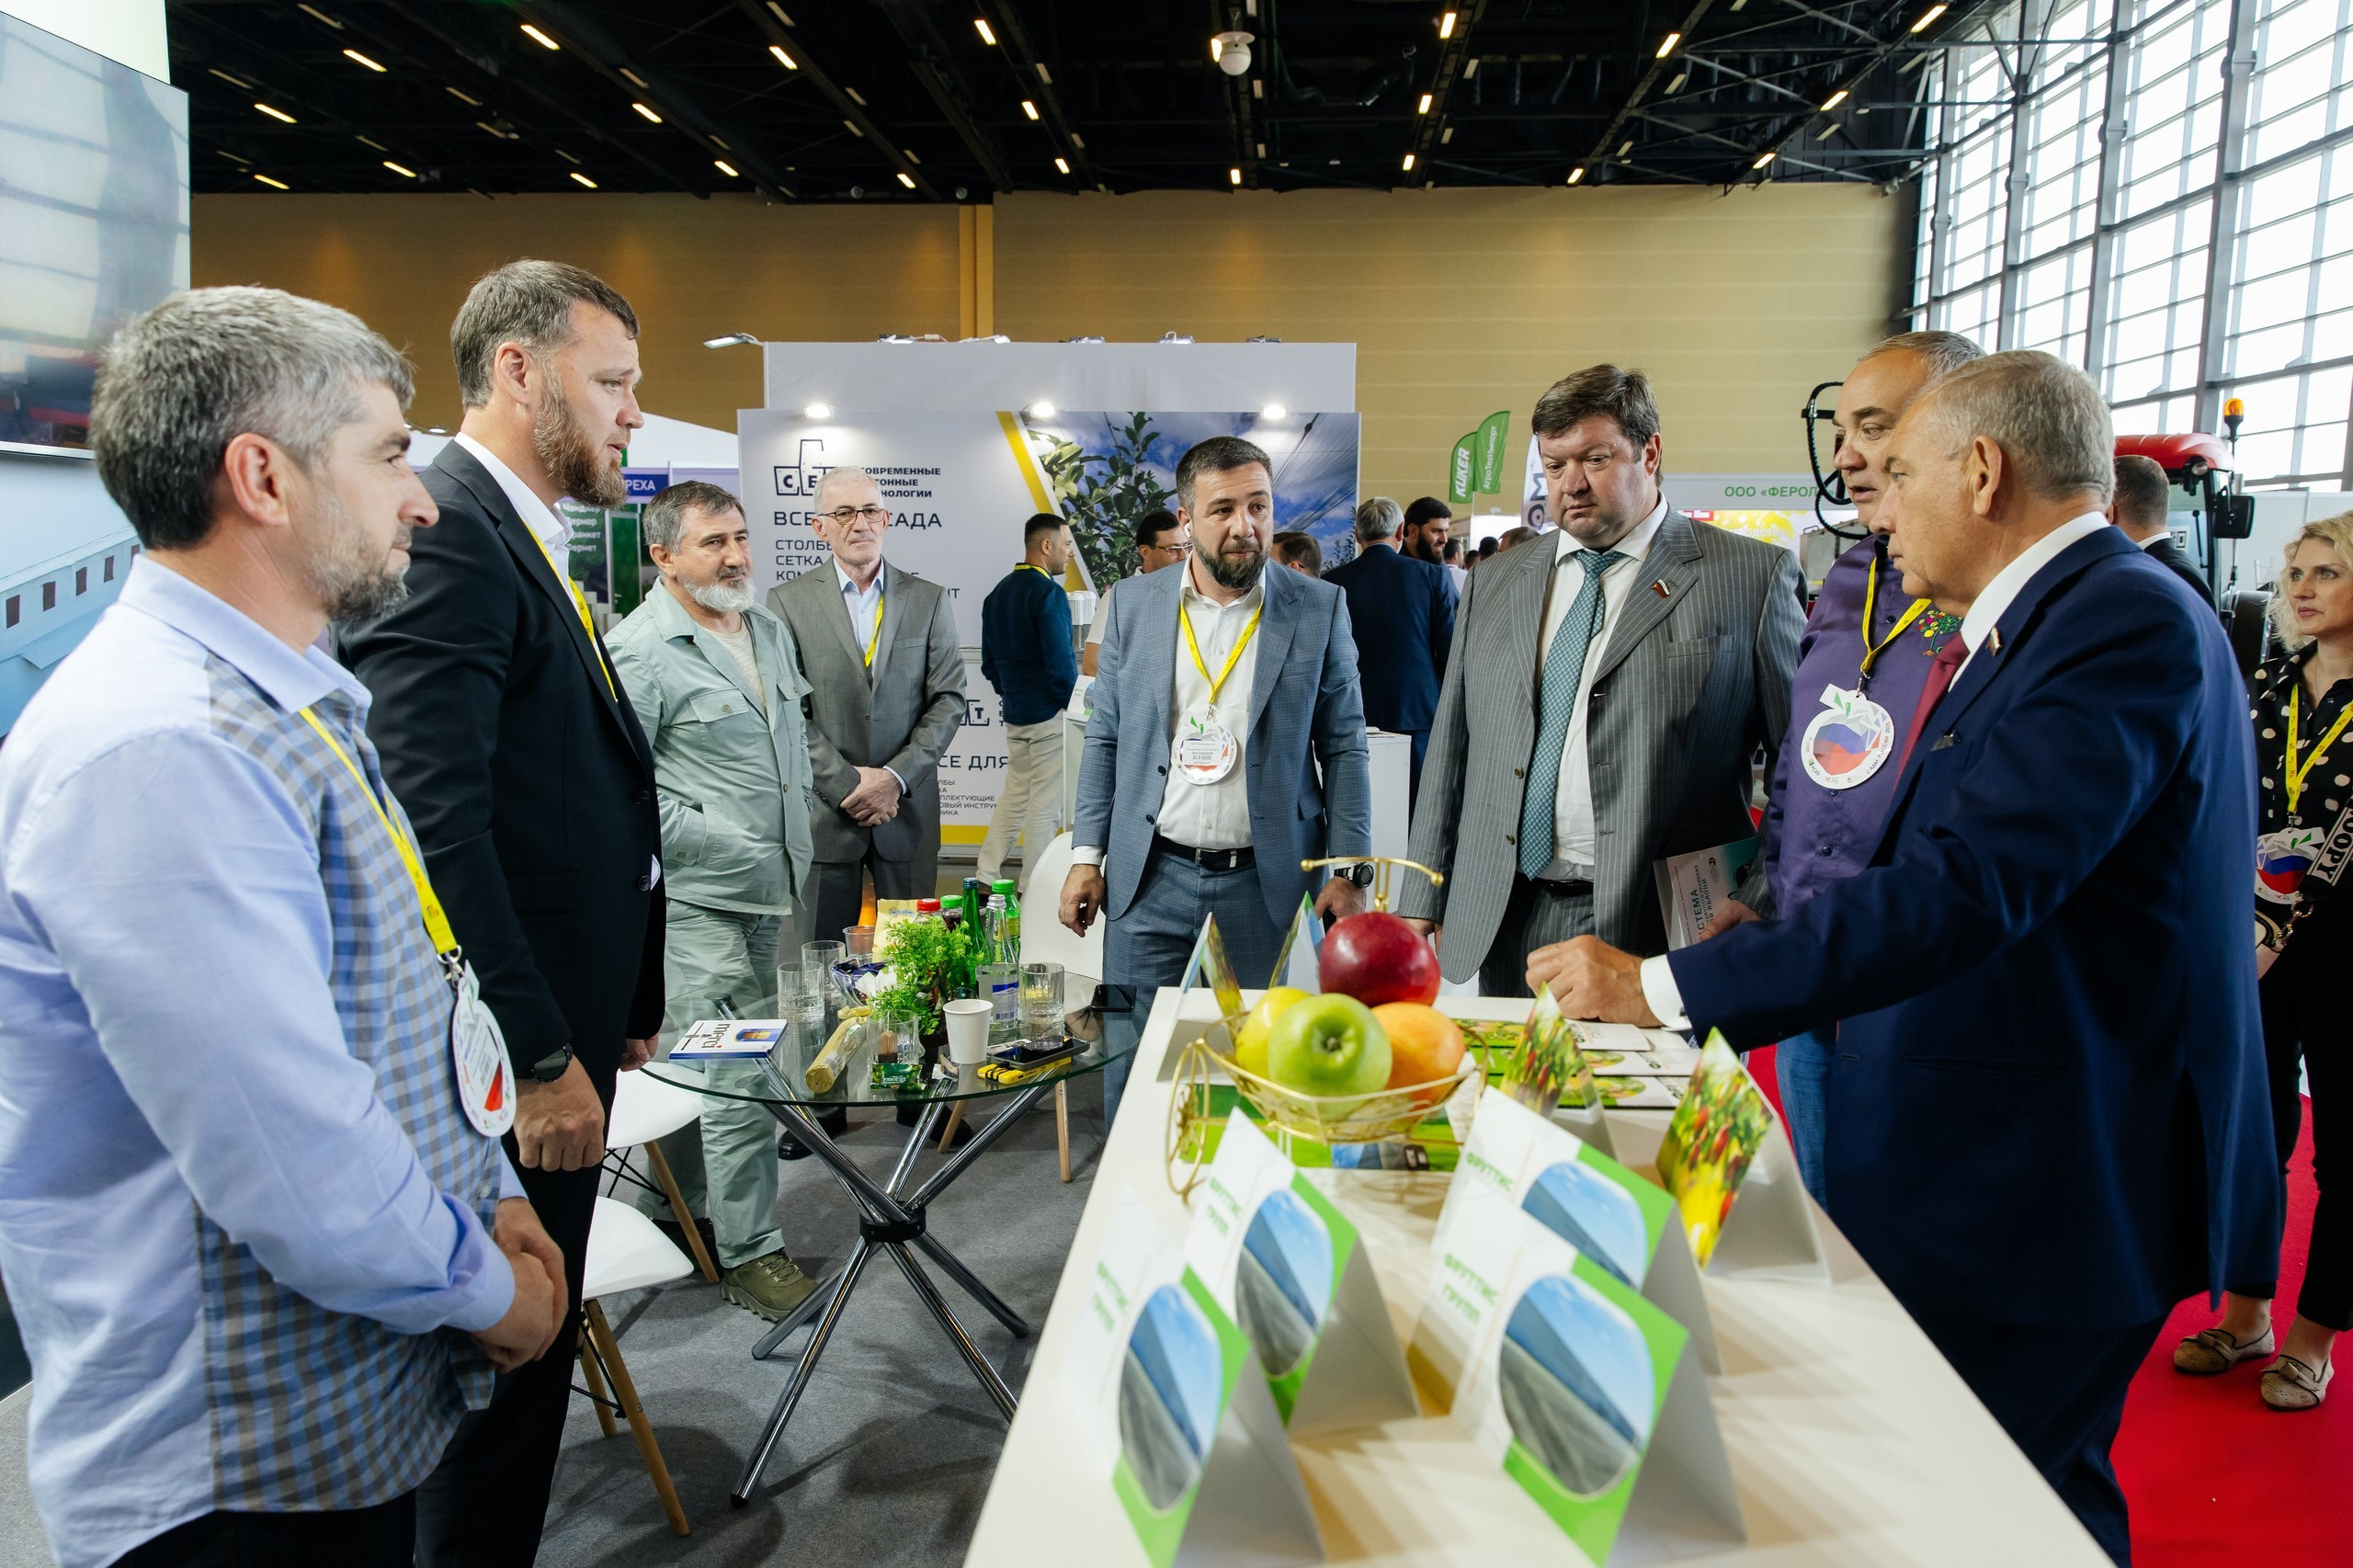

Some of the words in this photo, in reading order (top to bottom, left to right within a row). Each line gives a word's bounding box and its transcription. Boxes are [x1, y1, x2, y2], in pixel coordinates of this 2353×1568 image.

[860, 467, 941, 475] ОВРЕМЕННЫЕ
[1455, 447, 1471, 498] KUKER
[625, 479, 656, 491] РЕХА
[1724, 486, 1756, 497] ООО
[1761, 486, 1835, 497] «ФЕРОЛ»
[776, 555, 824, 566] СЕТКА
[968, 756, 1008, 770] ДЛЯ
[939, 794, 995, 802] ПЛЕКТУЮЩИЕ
[939, 801, 962, 809] ОВЫЙ
[1690, 889, 1705, 935] СТЕМА
